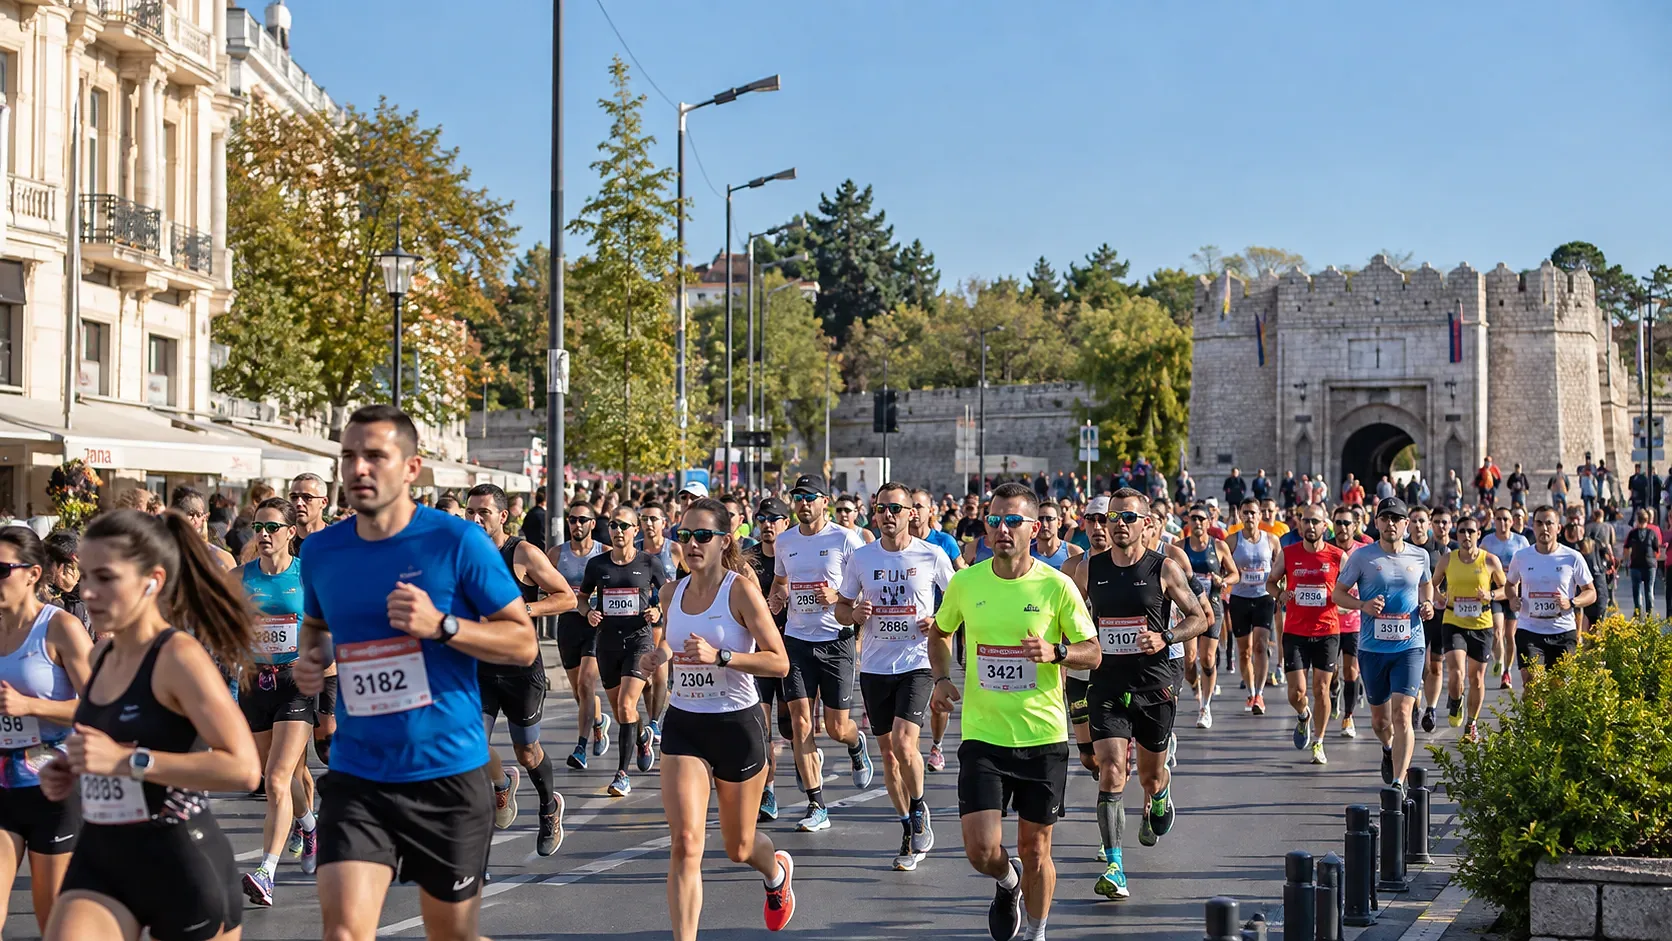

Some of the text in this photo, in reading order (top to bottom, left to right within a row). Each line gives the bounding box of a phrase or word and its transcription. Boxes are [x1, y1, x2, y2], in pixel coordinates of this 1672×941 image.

[880, 621, 908, 632] 2686
[1108, 633, 1137, 644] 3107
[987, 664, 1023, 679] 3421
[353, 669, 408, 696] 3182
[680, 672, 714, 687] 2304
